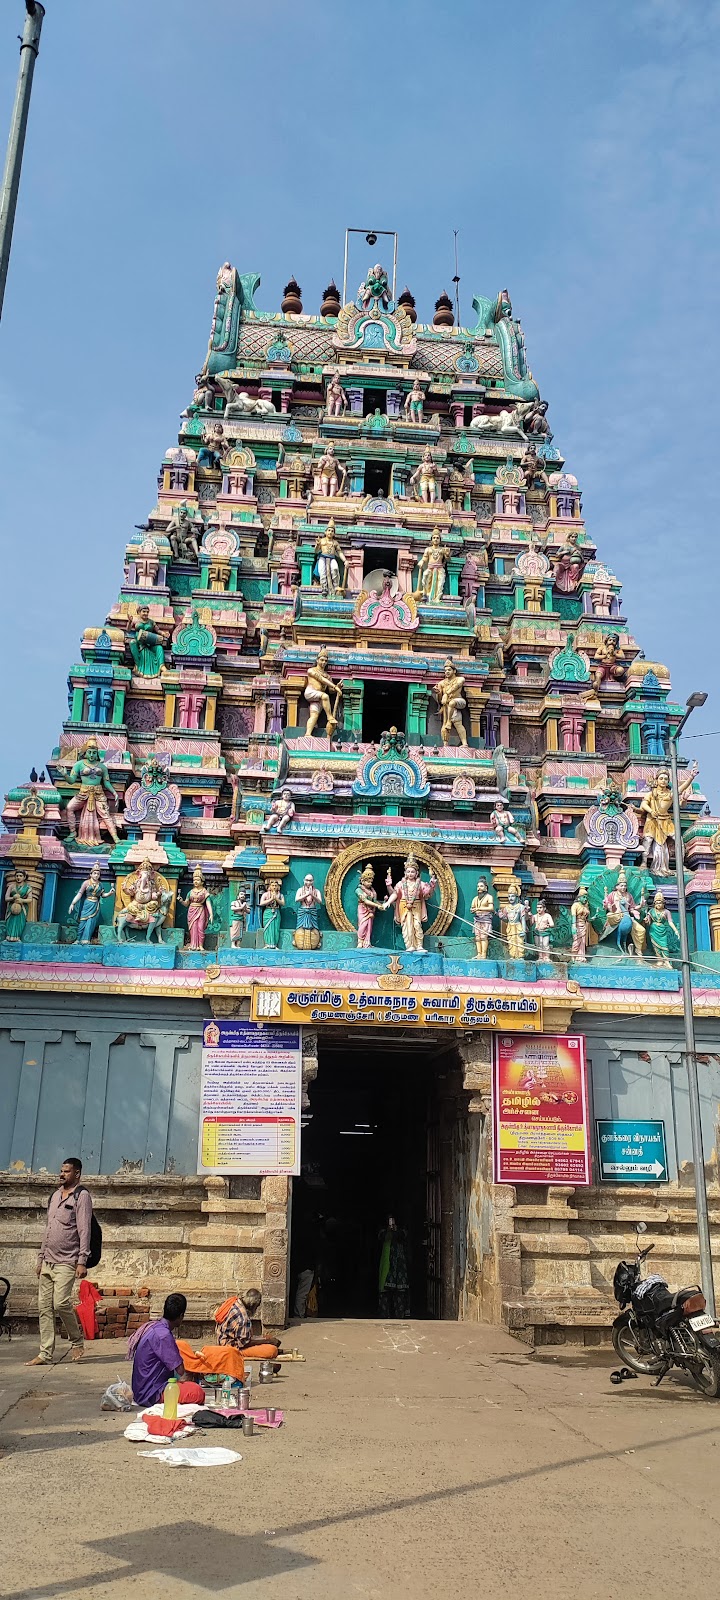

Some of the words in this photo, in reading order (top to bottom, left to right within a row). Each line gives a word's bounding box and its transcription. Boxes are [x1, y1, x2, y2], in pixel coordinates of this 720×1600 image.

[287, 990, 342, 1006] அருள்மிகு
[348, 992, 416, 1008] உத்வாகநாத
[422, 995, 460, 1009] சுவாமி
[465, 997, 538, 1013] திருக்கோயில்
[311, 1009, 375, 1021] திருமணஞ்சேரி
[425, 1012, 455, 1024] பரிகார
[501, 1096, 541, 1108] தமிழில்
[633, 1132, 661, 1143] விநாயகர்
[610, 1164, 638, 1172] செல்லும்
